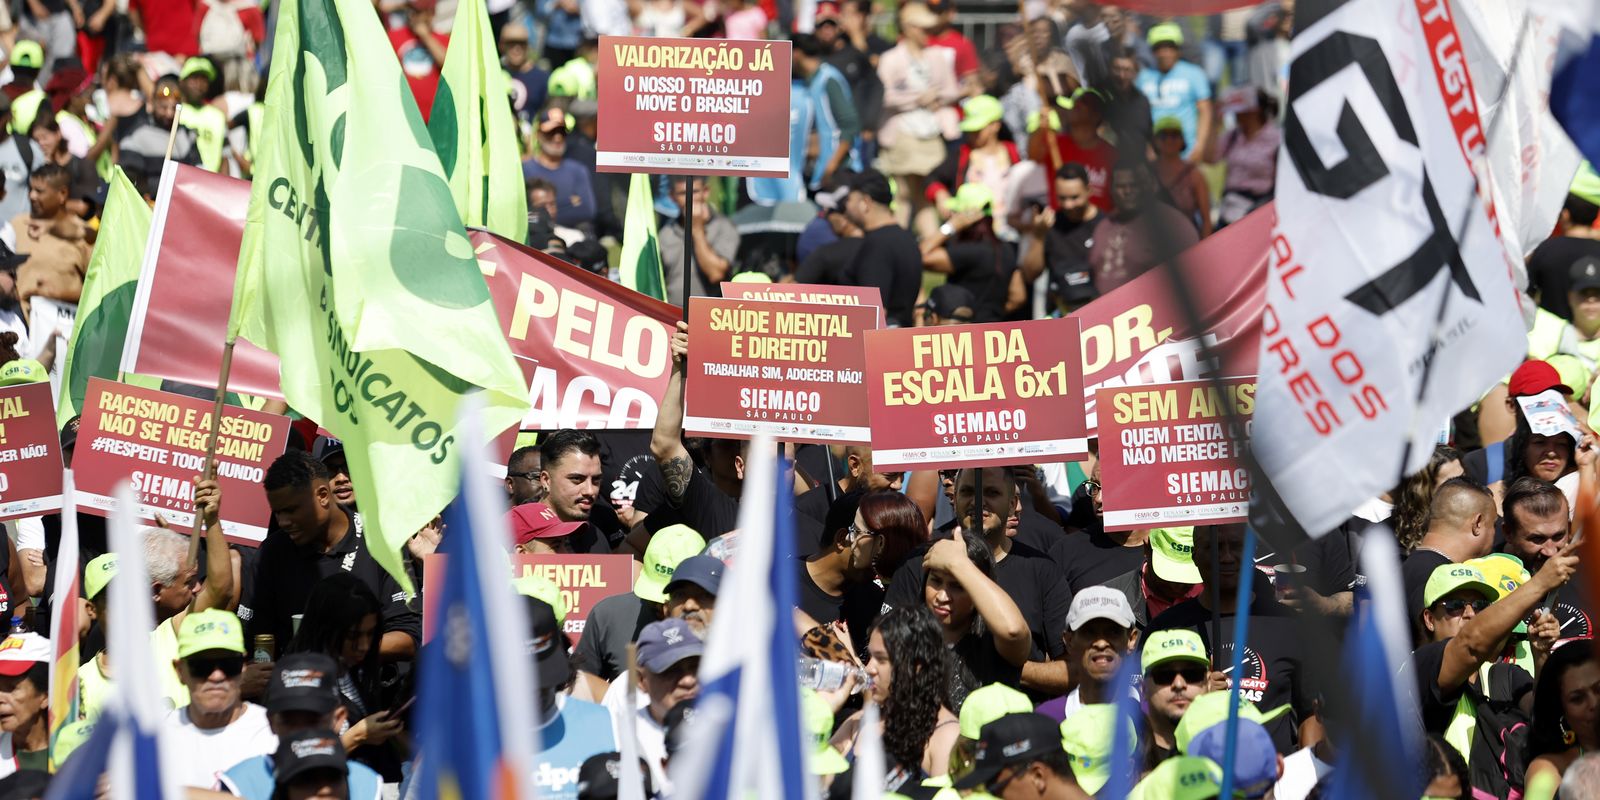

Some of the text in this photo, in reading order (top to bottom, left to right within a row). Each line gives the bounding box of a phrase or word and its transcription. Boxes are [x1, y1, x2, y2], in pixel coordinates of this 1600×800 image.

[614, 42, 774, 75] VALORIZAÇÃO JÁ
[624, 75, 763, 97] O NOSSO TRABALHO
[635, 94, 750, 114] MOVE O BRASIL!
[653, 121, 736, 145] SIEMACO
[660, 143, 728, 153] SÃO PAULO
[508, 271, 668, 379] PELO
[710, 304, 852, 338] SAÚDE MENTAL
[748, 336, 827, 362] DIREITO!
[912, 328, 1030, 369] FIM DA
[703, 362, 863, 384] TRABALHAR SIM, ADOECER NÃO!
[1306, 314, 1389, 420] DOS
[883, 361, 1068, 406] ESCALA 6x1
[740, 387, 821, 413] SIEMACO
[1113, 383, 1257, 425] SEM ANIS
[98, 391, 273, 443] RACISMO E ASÉDIO
[98, 411, 136, 437] NÃO
[139, 420, 162, 442] SE
[746, 410, 813, 421] SÃO PAULO
[933, 408, 1027, 435] SIEMACO
[943, 431, 1020, 444] SÃO PAULO
[1121, 426, 1170, 446] QUEM
[1173, 422, 1223, 443] TENTA
[20, 444, 48, 461] NÃO!
[91, 436, 169, 465] #RESPEITE
[217, 461, 264, 484] MUNDO
[1122, 444, 1156, 465] NÃO
[1161, 441, 1228, 464] MERECE
[130, 471, 196, 502] SIEMA
[610, 480, 640, 500] 24
[1167, 468, 1252, 495] SIEMAC
[1176, 494, 1202, 504] SÃO
[1171, 541, 1192, 553] CSB
[655, 563, 674, 575] CSB
[1450, 569, 1473, 577] CSB
[1162, 639, 1184, 649] CSB
